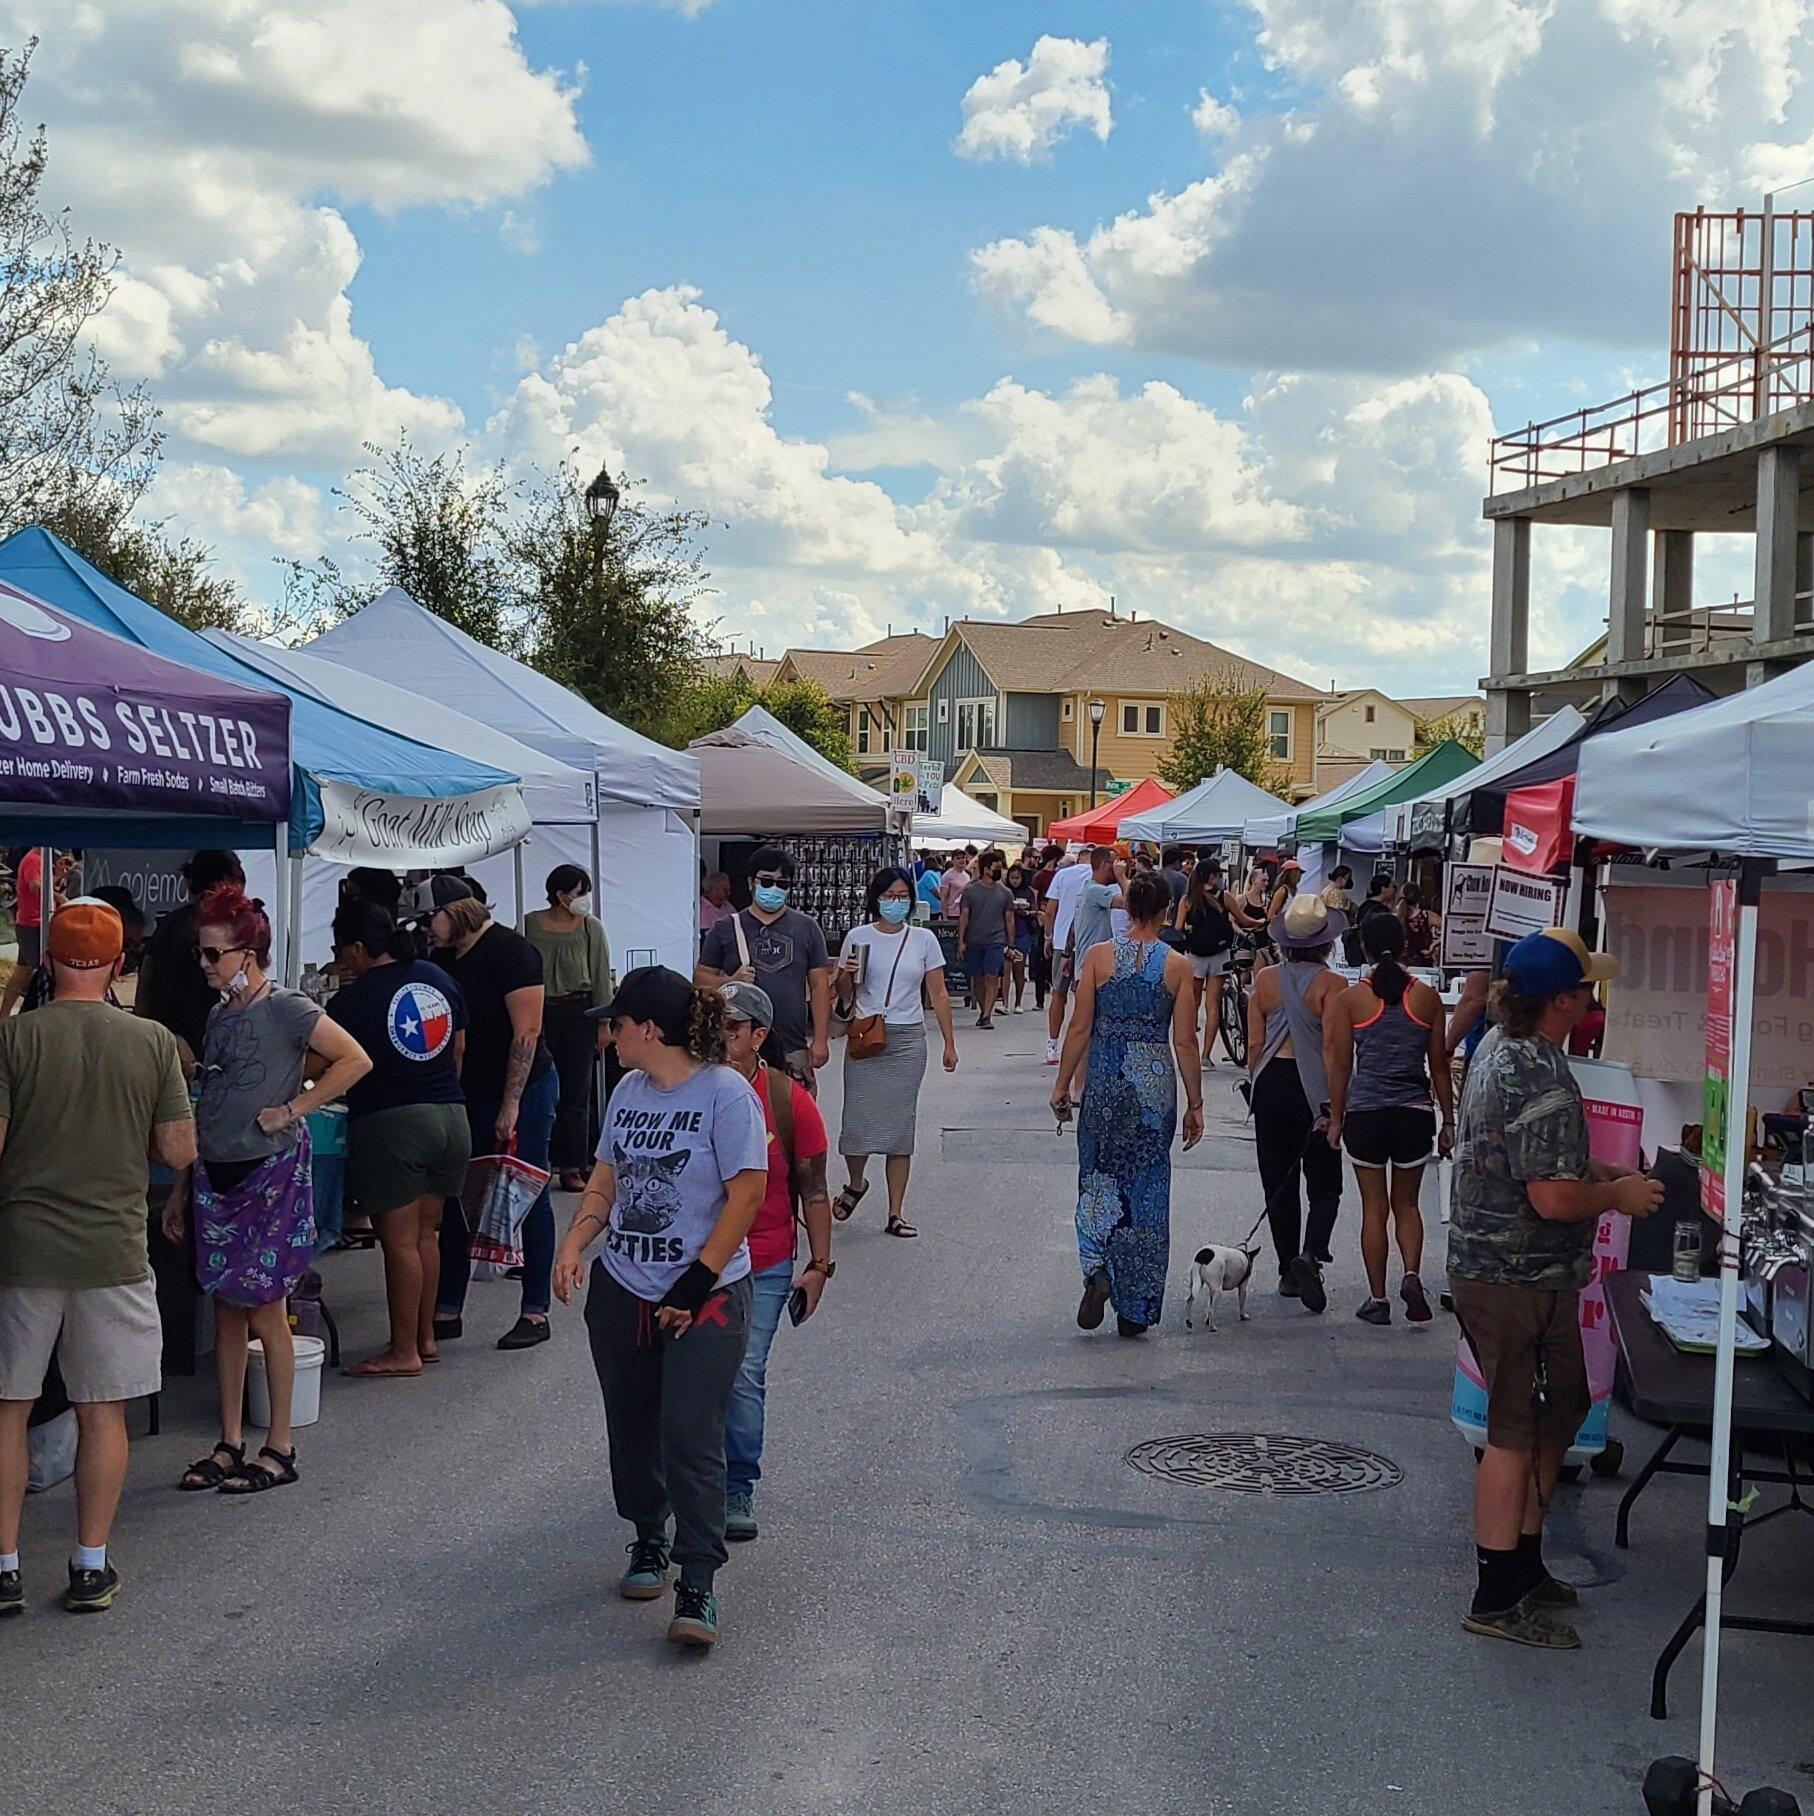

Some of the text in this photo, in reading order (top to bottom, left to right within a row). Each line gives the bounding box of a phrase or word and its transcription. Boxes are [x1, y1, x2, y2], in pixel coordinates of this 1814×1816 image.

[0, 684, 262, 769] UBBS SELTZER
[895, 755, 915, 765] CBD
[16, 757, 50, 778] Home
[51, 760, 93, 784] Delivery
[117, 765, 140, 785] Farm
[141, 767, 164, 787] Fresh
[165, 770, 189, 790] Sodas
[210, 776, 228, 794] Small
[362, 798, 491, 854] Goat Milk Soap
[1499, 879, 1519, 895] NOW
[1519, 883, 1552, 902] HIRING
[70, 958, 100, 967] TEXAS
[613, 1108, 703, 1133] SHOW ME
[623, 1129, 676, 1150] YOUR
